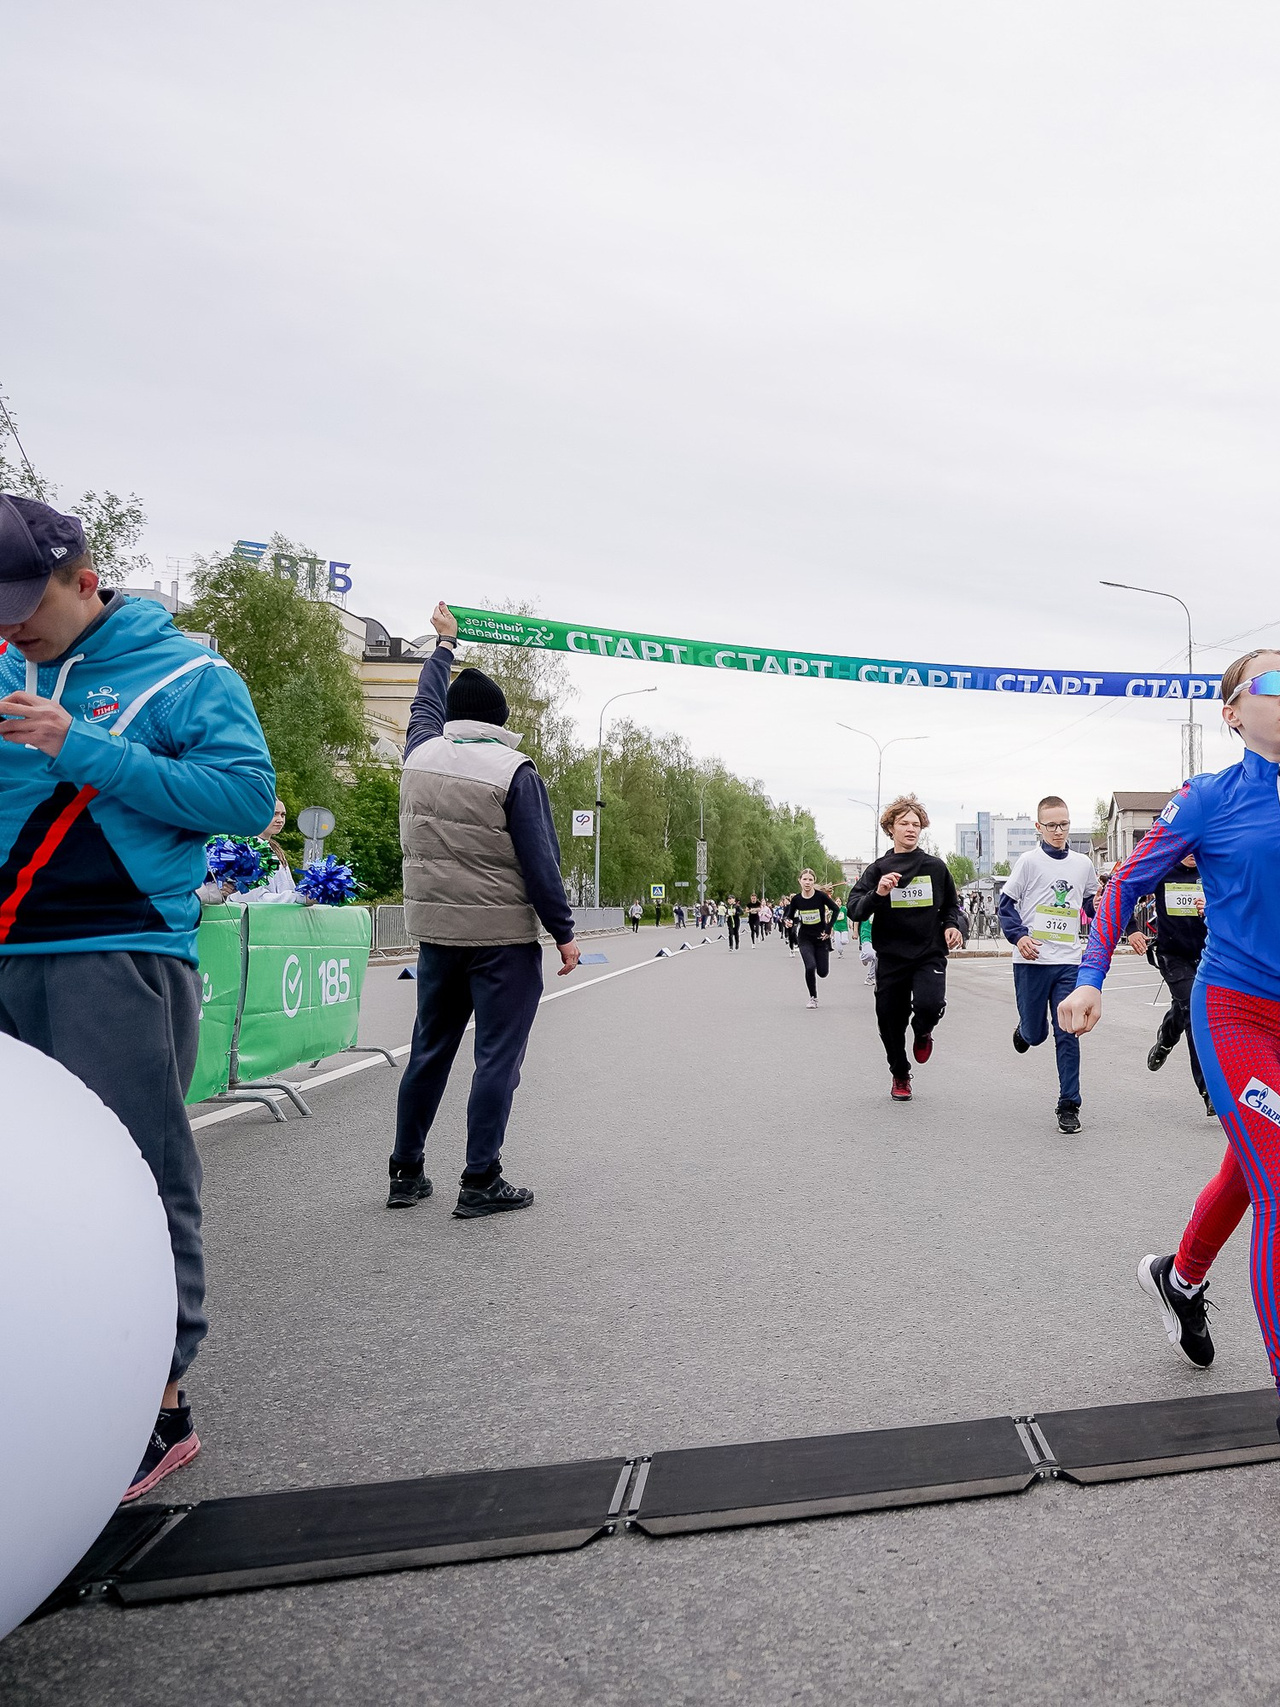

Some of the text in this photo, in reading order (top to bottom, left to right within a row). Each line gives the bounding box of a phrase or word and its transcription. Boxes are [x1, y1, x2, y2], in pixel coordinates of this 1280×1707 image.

[274, 552, 353, 594] ВТБ
[458, 626, 520, 643] марафон
[465, 617, 524, 633] зелёный
[566, 631, 688, 665] СТАРТ
[714, 650, 833, 679] СТАРТ
[857, 664, 972, 689] СТАРТ
[995, 673, 1104, 696] СТАРТ
[1125, 678, 1222, 699] СТАРТ
[901, 889, 923, 898] 3198
[1046, 920, 1067, 931] 3149
[318, 958, 350, 1007] 185
